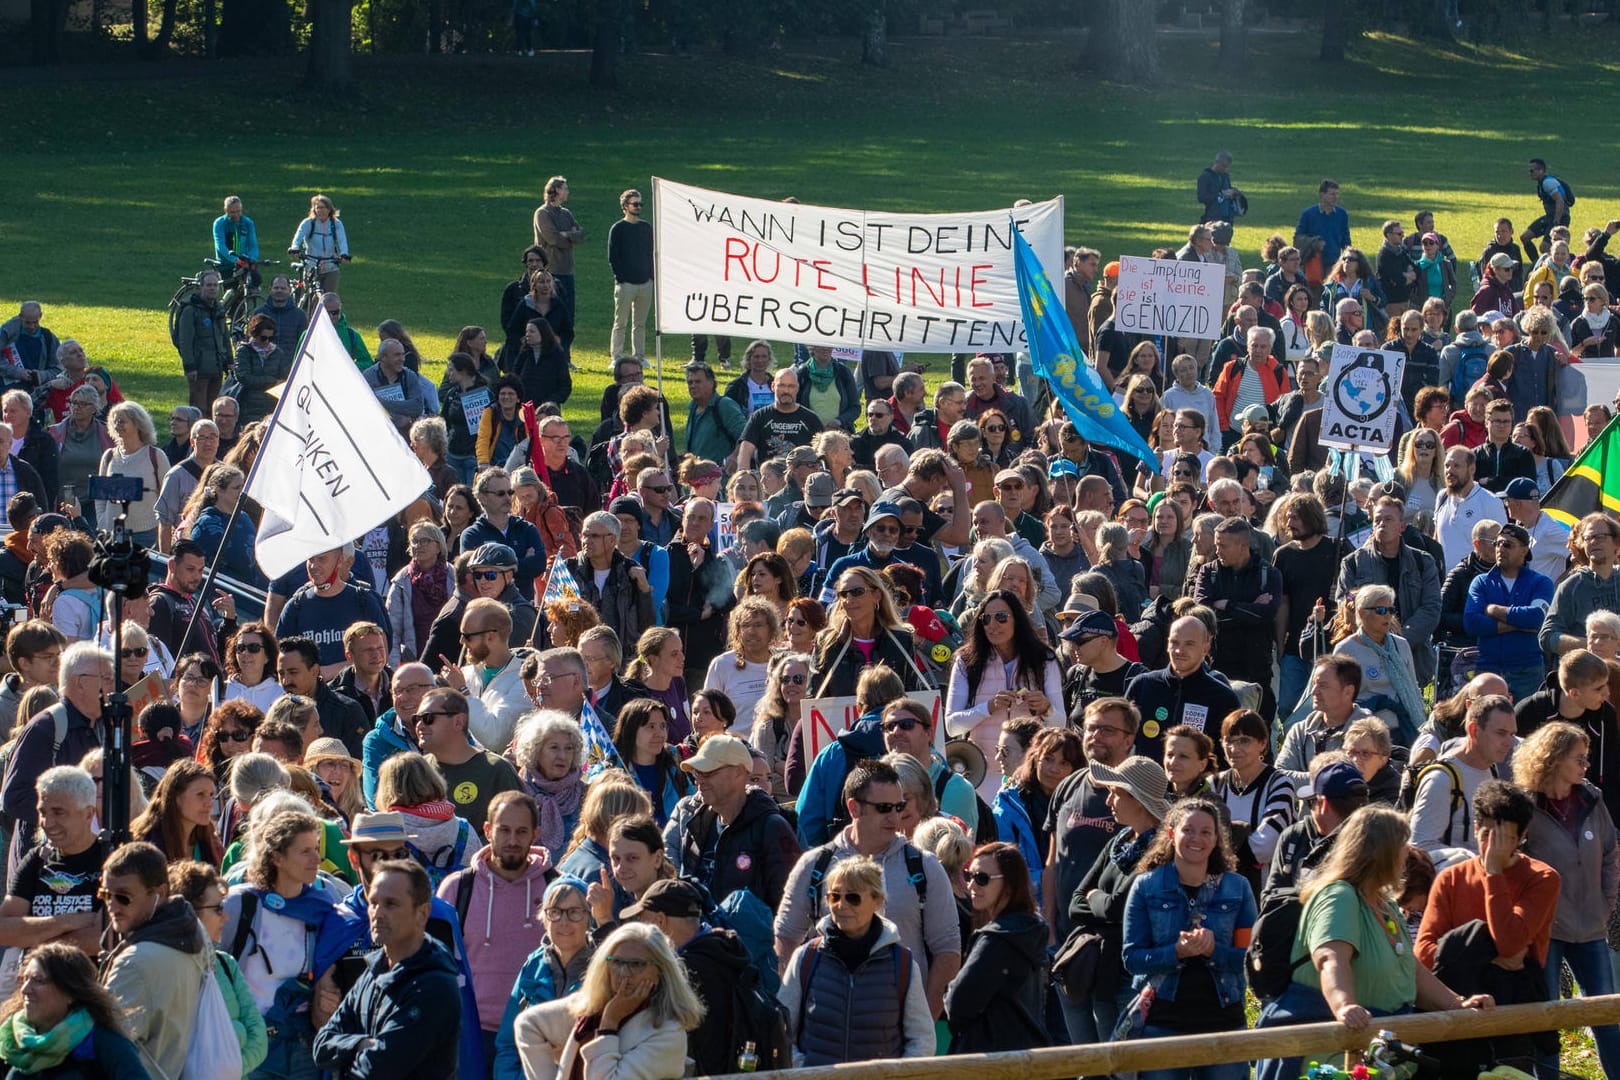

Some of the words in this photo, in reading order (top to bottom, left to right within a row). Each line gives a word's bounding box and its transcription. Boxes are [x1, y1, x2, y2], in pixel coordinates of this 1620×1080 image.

[688, 199, 795, 243] WANN
[819, 220, 893, 251] IST
[1121, 256, 1137, 272] Die
[863, 263, 993, 307] LINIE
[1141, 279, 1154, 290] ist
[1118, 286, 1136, 301] sie
[1142, 291, 1156, 303] ist
[1120, 303, 1209, 334] GENOZID
[1328, 422, 1385, 443] ACTA
[32, 894, 53, 905] FOR
[53, 894, 92, 905] JUSTICE
[32, 905, 53, 917] FOR
